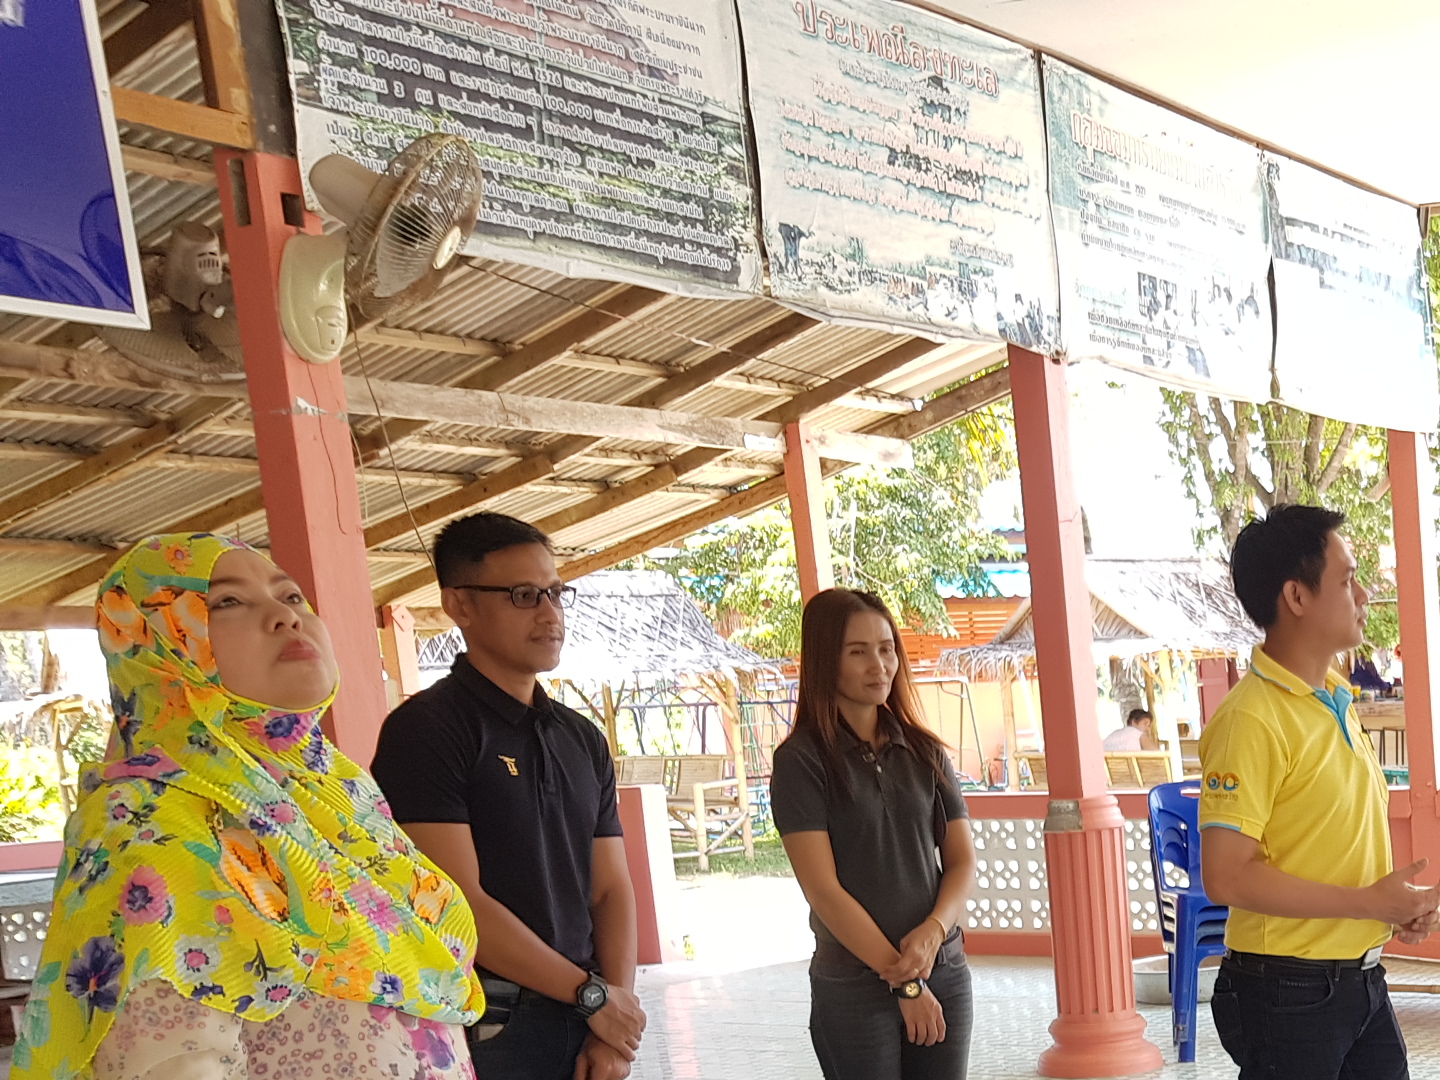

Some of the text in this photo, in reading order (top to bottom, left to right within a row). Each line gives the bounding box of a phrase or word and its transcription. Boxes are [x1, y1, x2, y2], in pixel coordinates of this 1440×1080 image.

[316, 32, 356, 57] จำนวน
[421, 63, 445, 81] บาท
[532, 65, 563, 87] 2526
[394, 82, 405, 98] 3
[414, 87, 434, 105] คน
